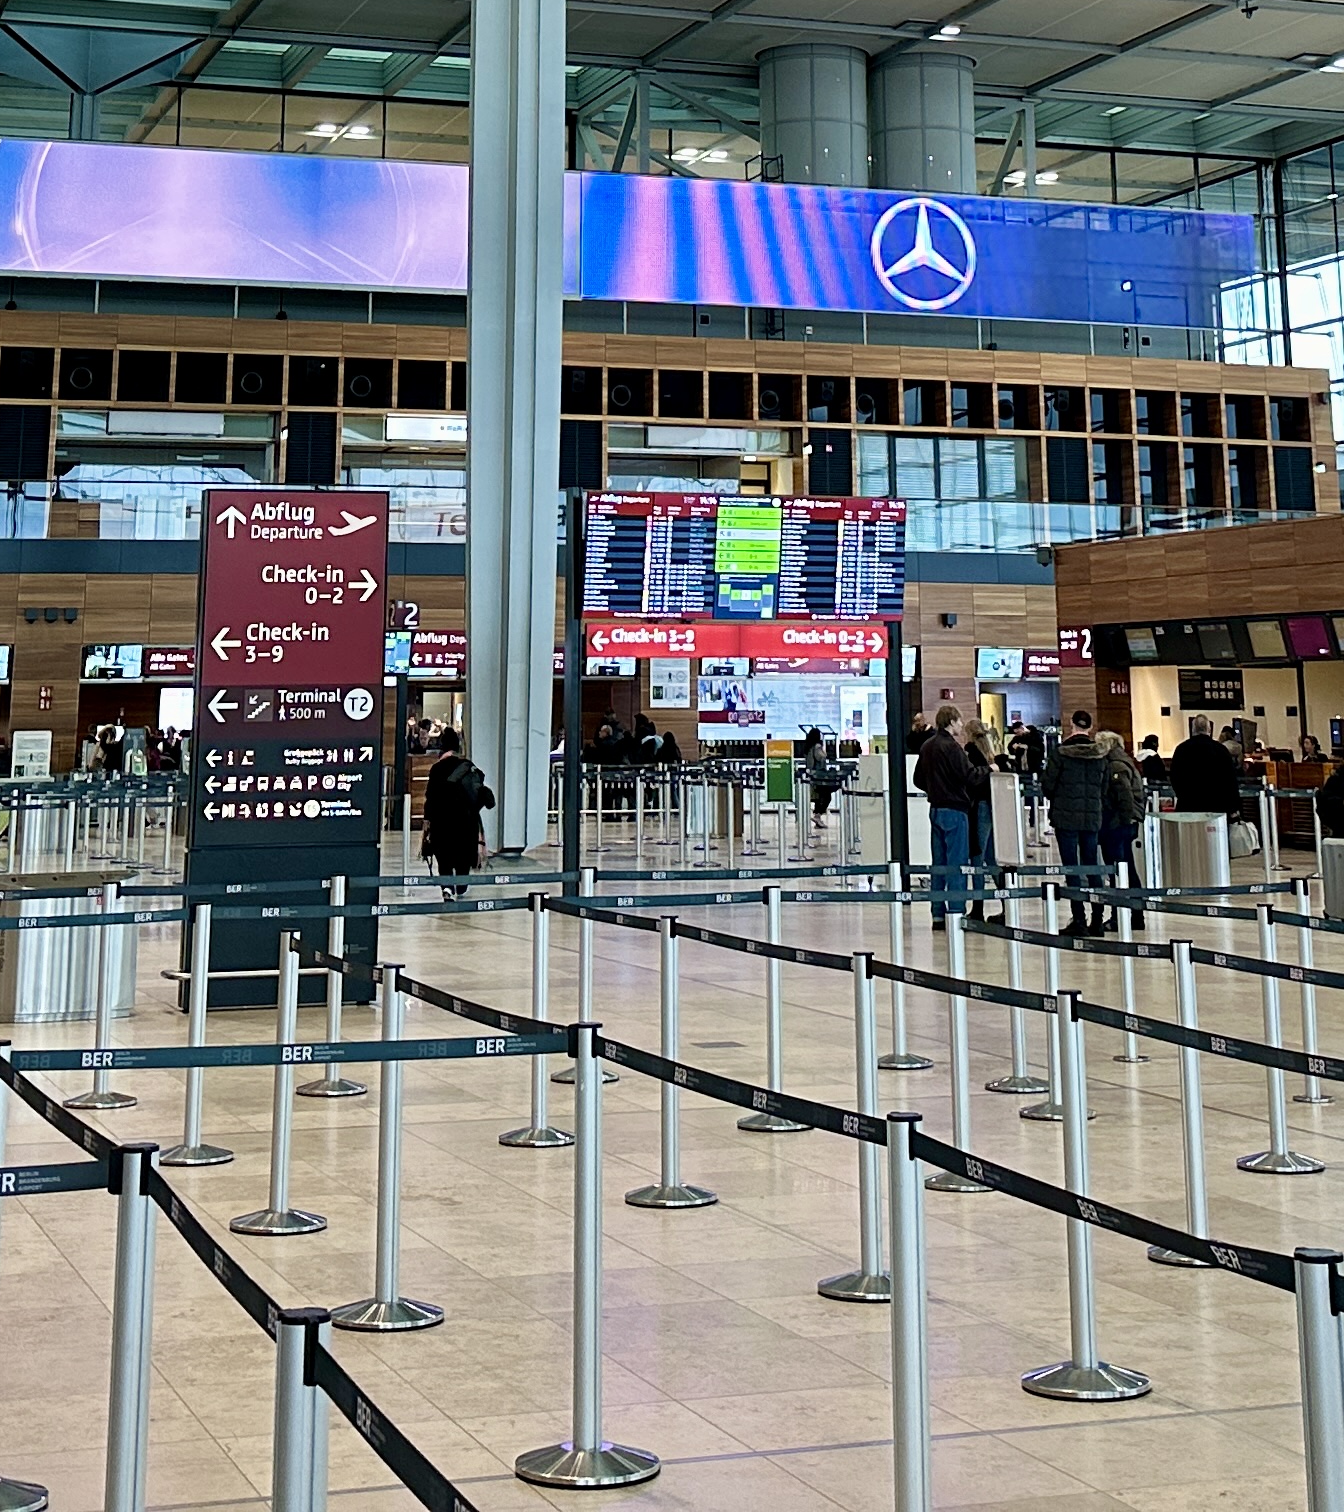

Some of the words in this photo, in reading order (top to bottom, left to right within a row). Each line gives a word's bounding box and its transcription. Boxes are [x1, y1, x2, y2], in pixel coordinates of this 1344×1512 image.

[250, 501, 315, 525] Abflug
[250, 525, 323, 542] Departure
[261, 564, 344, 583] Check-in
[305, 587, 344, 604] 0–2
[404, 602, 419, 626] 2
[246, 622, 330, 641] Check-in
[414, 632, 448, 646] Abflug
[611, 629, 668, 645] Check-in
[783, 630, 837, 645] Check-in
[1081, 628, 1092, 658] 2
[245, 645, 284, 663] 3–9
[278, 689, 341, 704] Terminal
[347, 696, 369, 713] T2
[289, 707, 314, 719] 500
[314, 709, 326, 719] m
[477, 901, 494, 911] BER
[896, 892, 912, 902] BER
[1124, 1015, 1139, 1031] BER
[281, 1046, 312, 1061] BER
[475, 1038, 505, 1054] BER
[81, 1052, 113, 1067] BER
[753, 1090, 768, 1110] BER
[843, 1114, 860, 1135] BER
[966, 1157, 984, 1182] BER
[1079, 1199, 1100, 1223] BER
[1210, 1244, 1242, 1269] BER
[356, 1396, 372, 1436] BER
